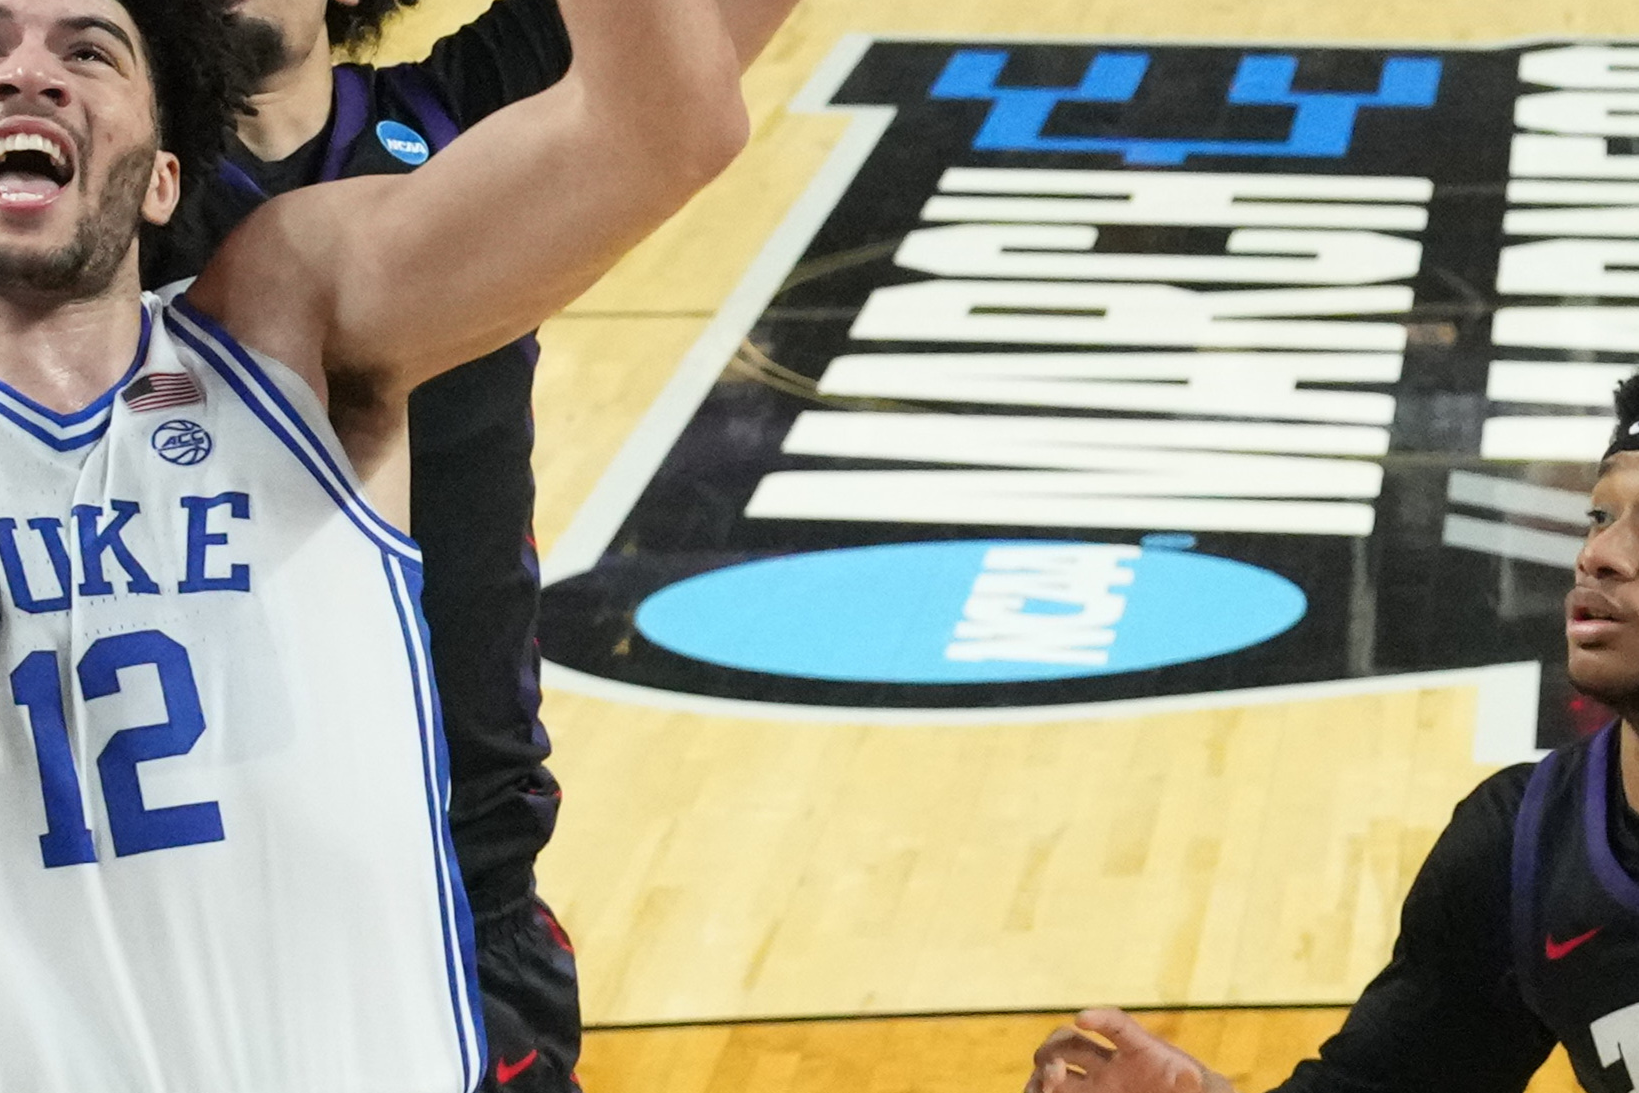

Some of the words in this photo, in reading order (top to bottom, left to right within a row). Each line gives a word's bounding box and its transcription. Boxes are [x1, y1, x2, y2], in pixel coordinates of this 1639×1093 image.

[386, 138, 428, 154] NCAA
[744, 167, 1434, 536] MARCH
[160, 428, 205, 450] ACC
[944, 544, 1143, 665] NCAA
[9, 629, 225, 869] 12
